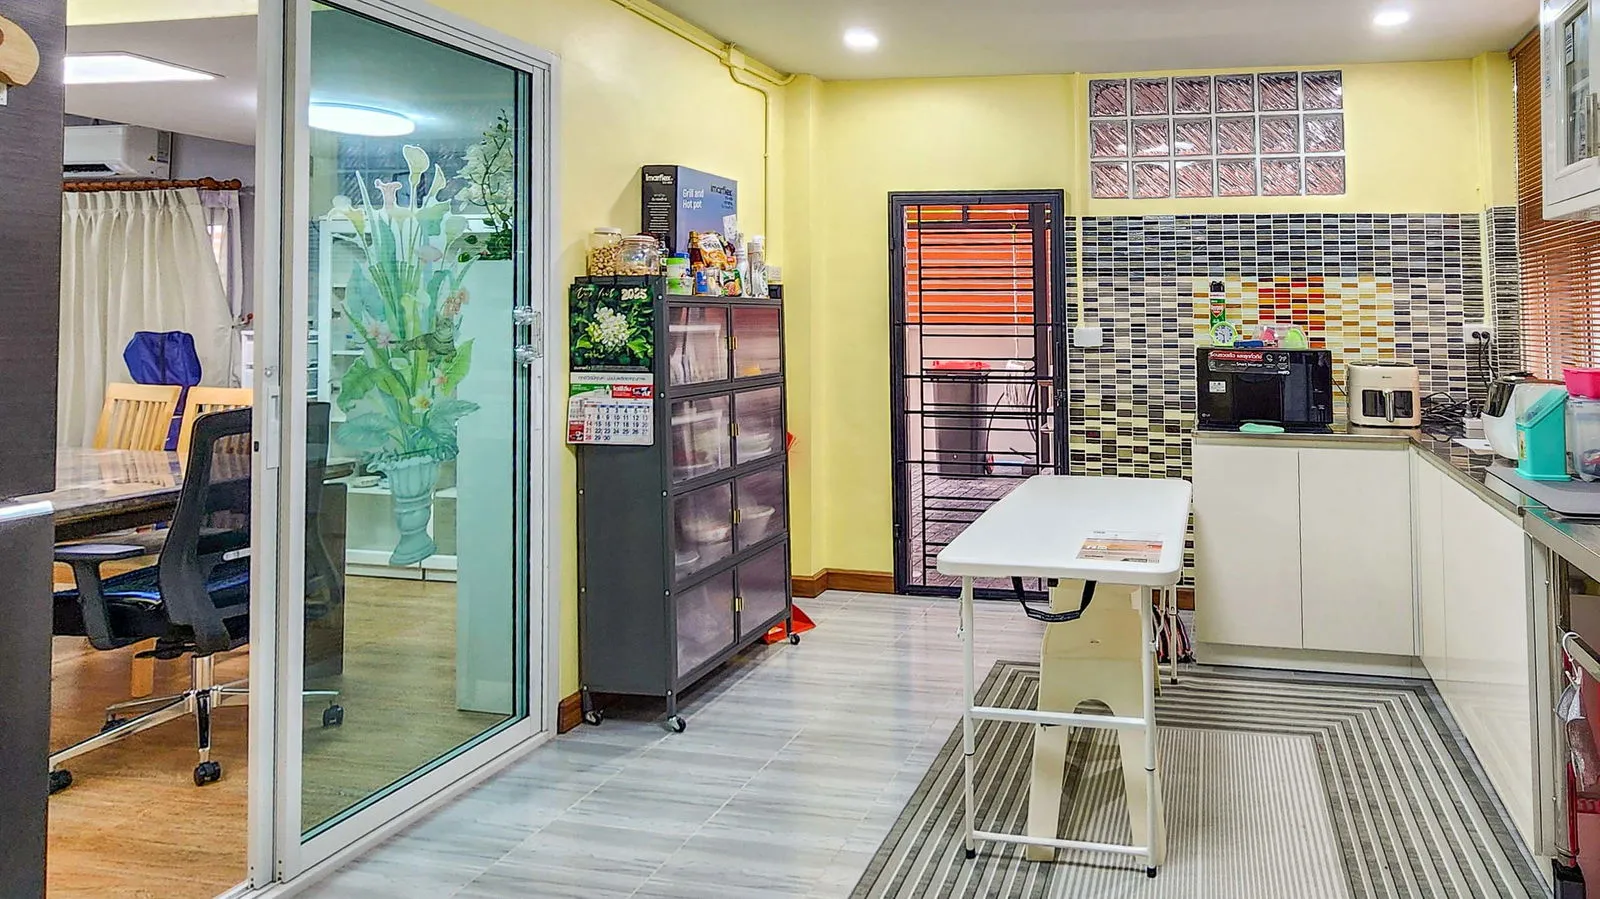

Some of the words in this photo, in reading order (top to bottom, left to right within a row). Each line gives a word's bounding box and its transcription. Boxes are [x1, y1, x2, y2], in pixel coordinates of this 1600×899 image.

[683, 189, 694, 198] Grill
[694, 189, 704, 198] and
[683, 200, 693, 208] Hot
[693, 200, 702, 210] pot
[621, 287, 647, 301] 2025
